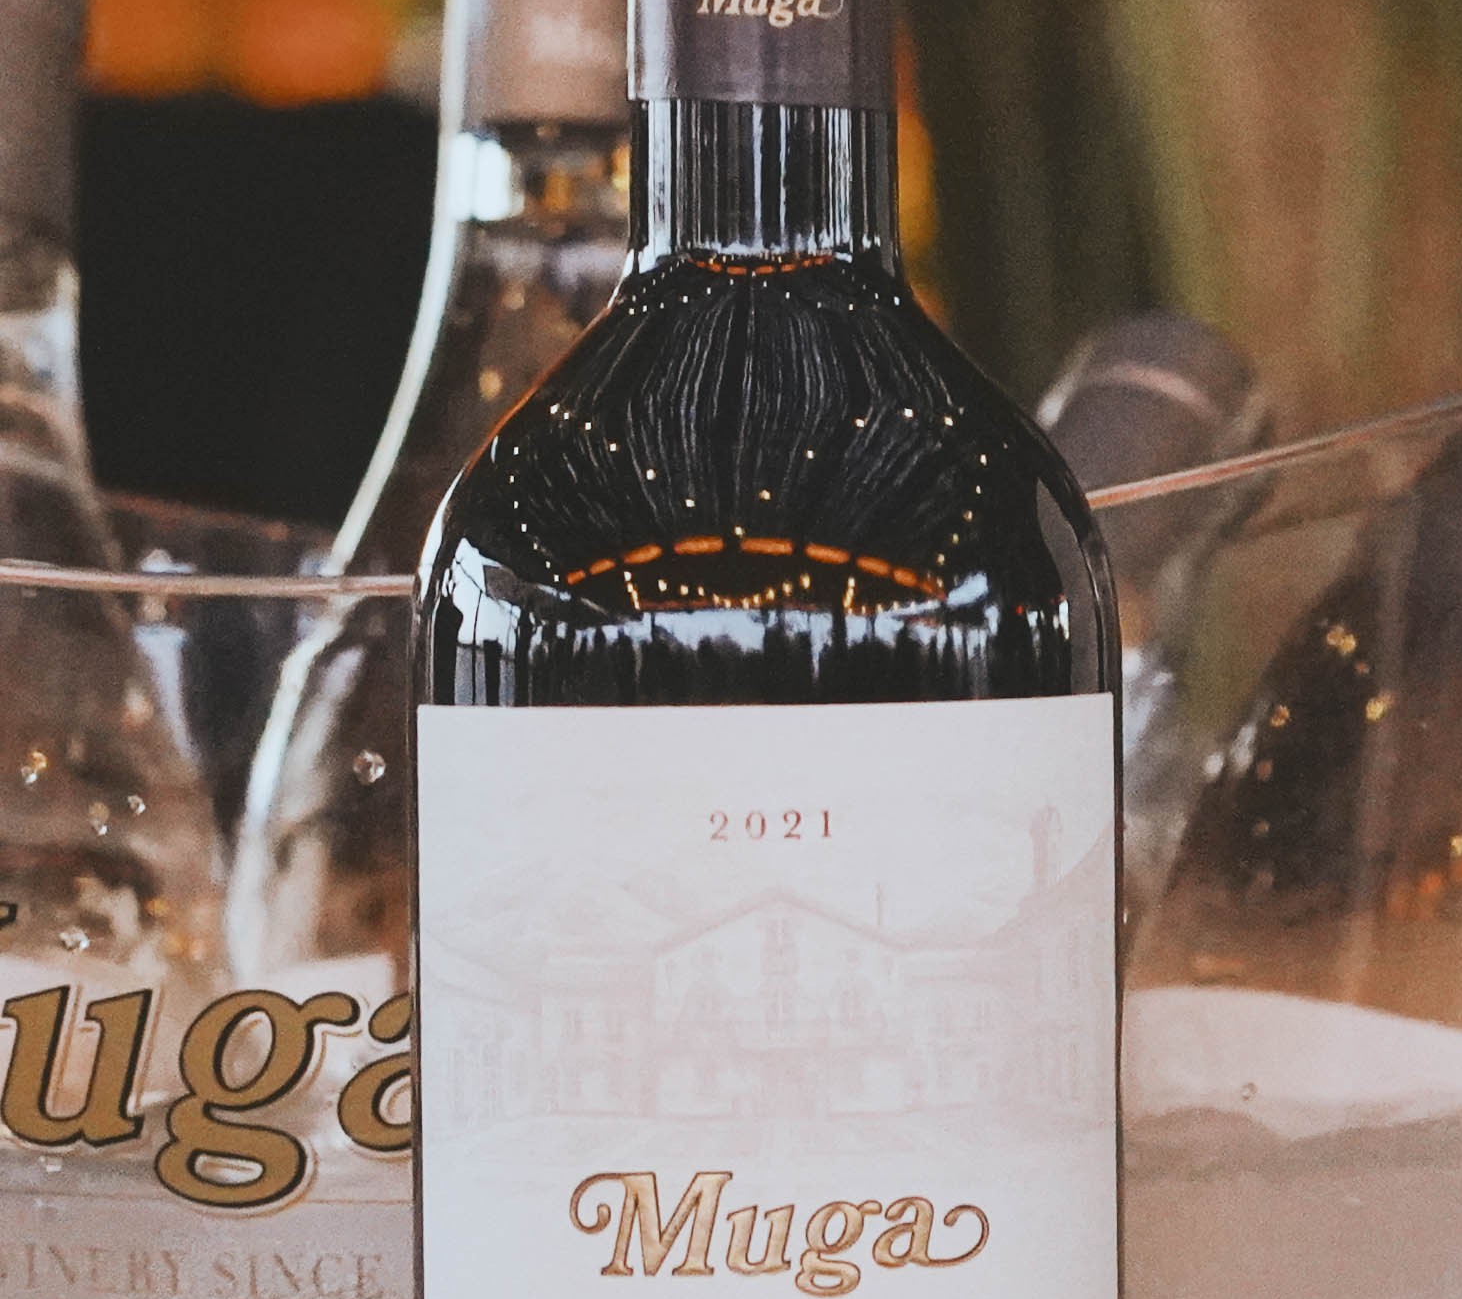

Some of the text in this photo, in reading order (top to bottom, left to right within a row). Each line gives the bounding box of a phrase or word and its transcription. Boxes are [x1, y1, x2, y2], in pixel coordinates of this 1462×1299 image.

[708, 808, 837, 844] 2021
[569, 1170, 990, 1299] Muga
[0, 1242, 184, 1295] INERY
